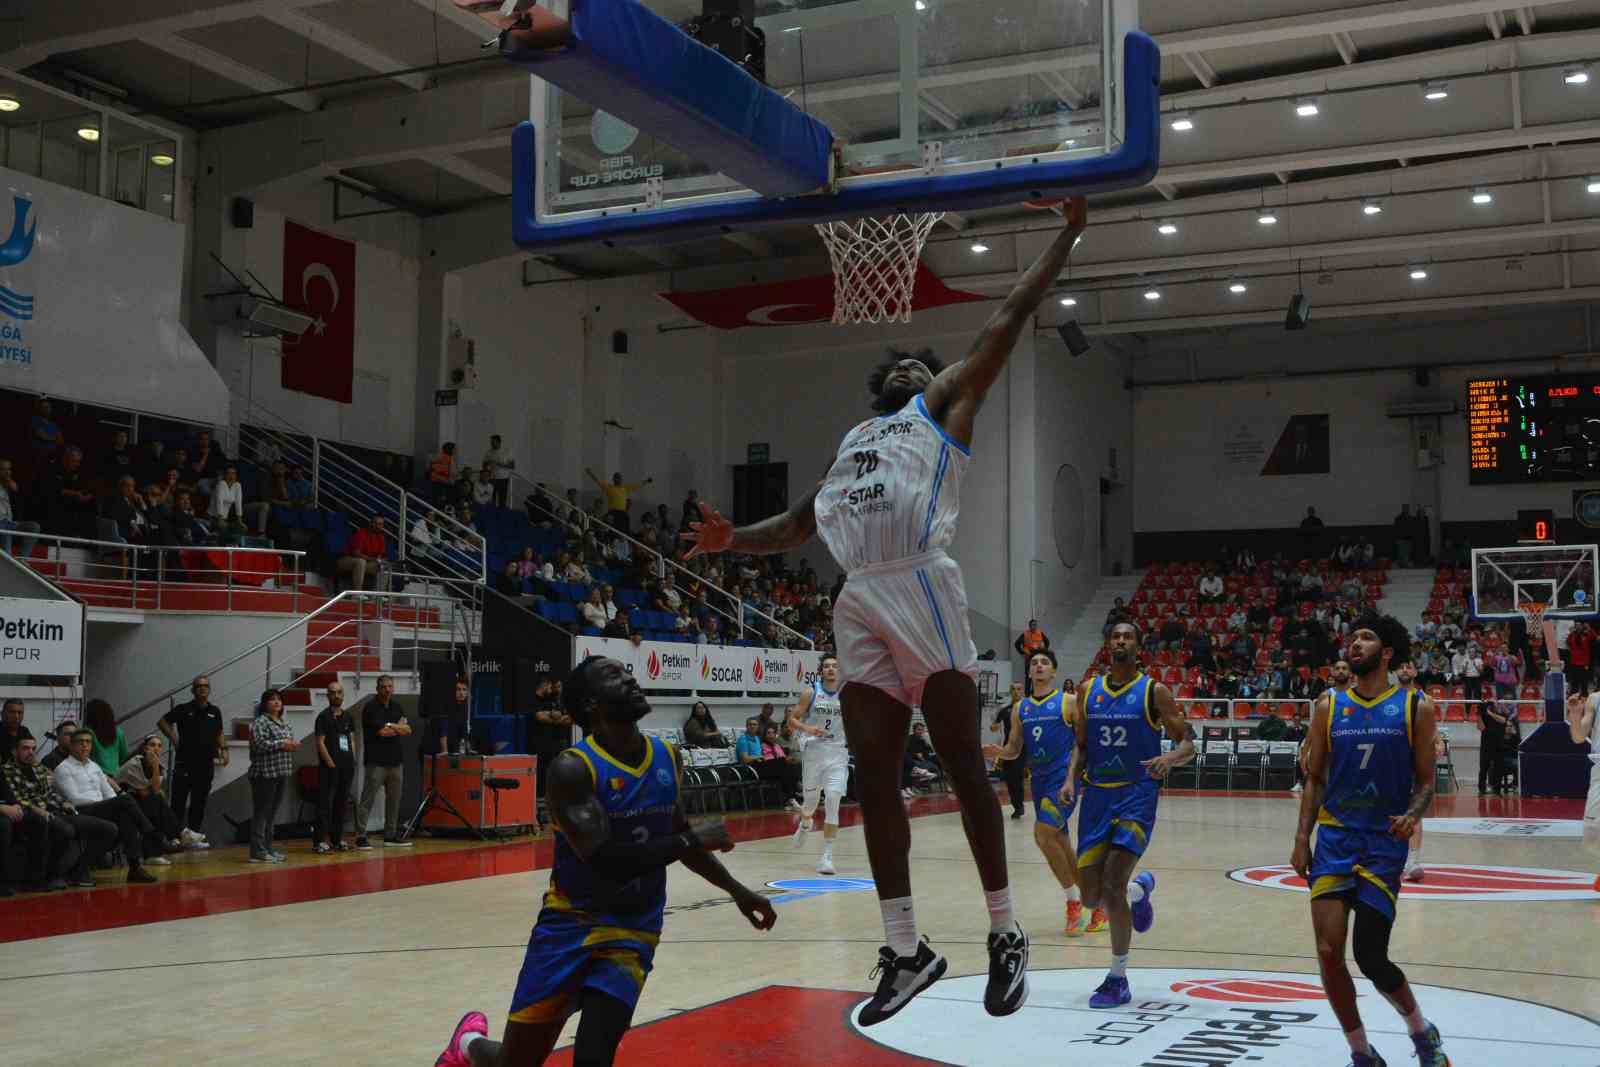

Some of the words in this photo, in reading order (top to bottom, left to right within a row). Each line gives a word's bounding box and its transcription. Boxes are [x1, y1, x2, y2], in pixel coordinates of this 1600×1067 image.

[848, 483, 885, 505] STAR
[1536, 521, 1546, 540] 0
[3, 647, 41, 660] POR
[661, 653, 690, 669] Petkim
[764, 660, 788, 673] Petkim
[710, 668, 742, 682] SOCAR
[825, 719, 832, 730] 2
[1032, 726, 1042, 741] 9
[1099, 725, 1128, 746] 32
[1356, 743, 1375, 769] 7
[1070, 1001, 1190, 1046] SPOR
